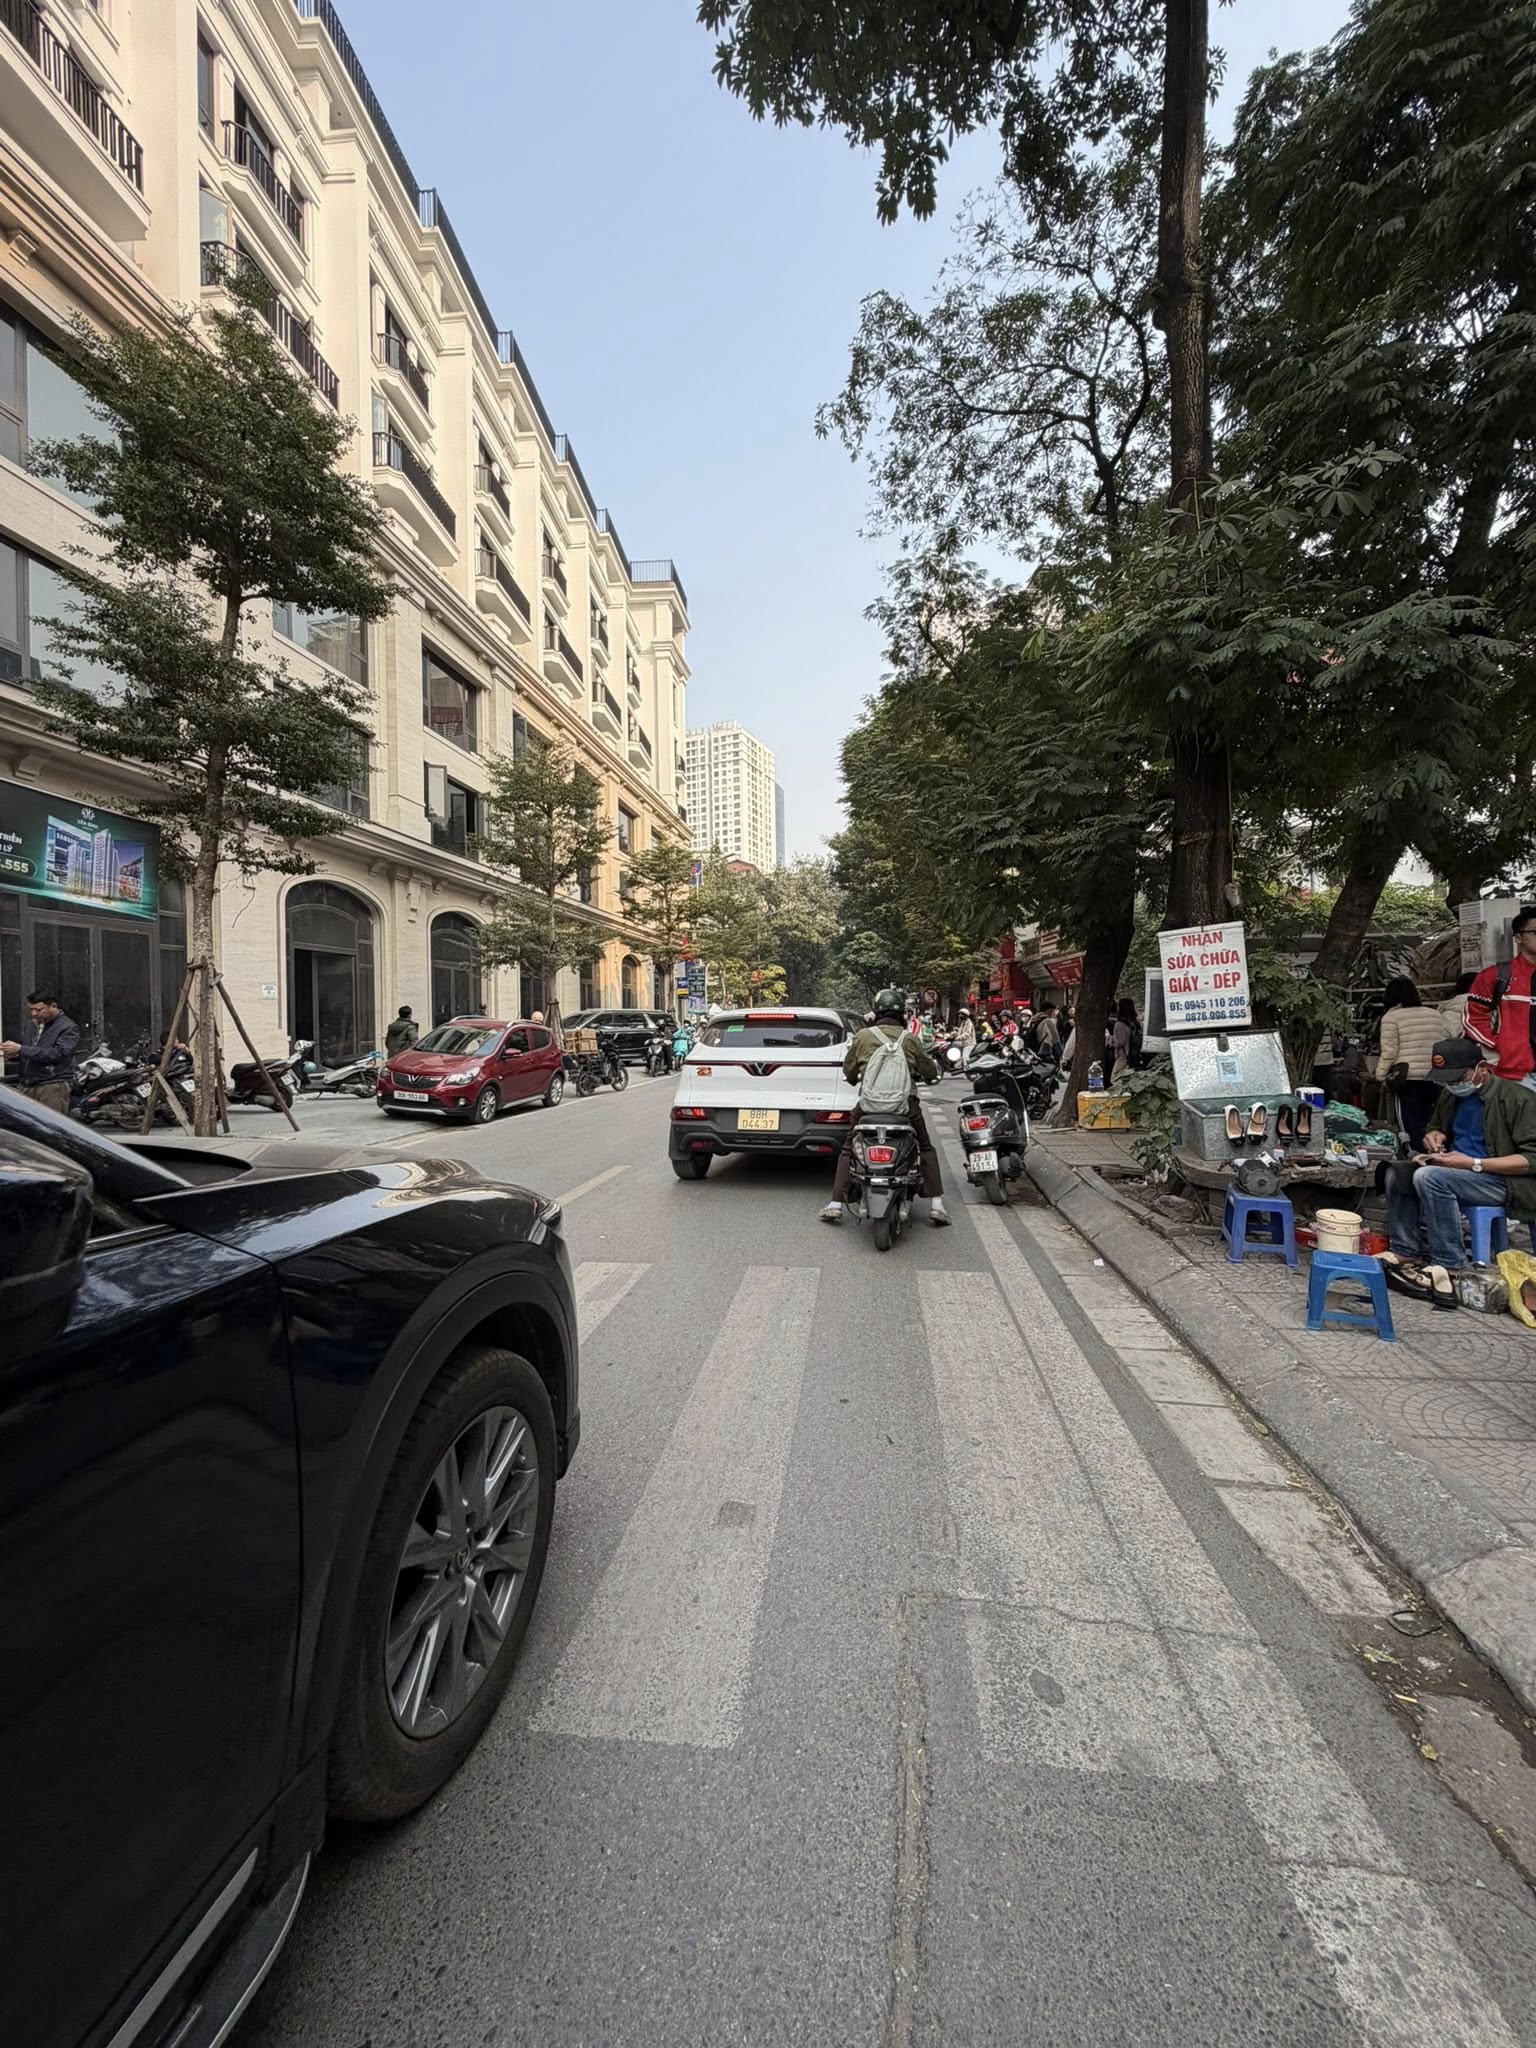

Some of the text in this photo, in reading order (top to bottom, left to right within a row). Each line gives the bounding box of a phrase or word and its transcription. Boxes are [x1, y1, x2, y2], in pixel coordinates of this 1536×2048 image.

[0, 858, 29, 873] .555
[1167, 948, 1241, 970] SỬA CHỮA
[1213, 968, 1241, 989] DÉP
[1185, 999, 1206, 1010] 0945
[1210, 998, 1225, 1008] 110
[1186, 1012, 1207, 1022] 0876
[1229, 1008, 1247, 1019] 855
[742, 1119, 774, 1128] 044.37
